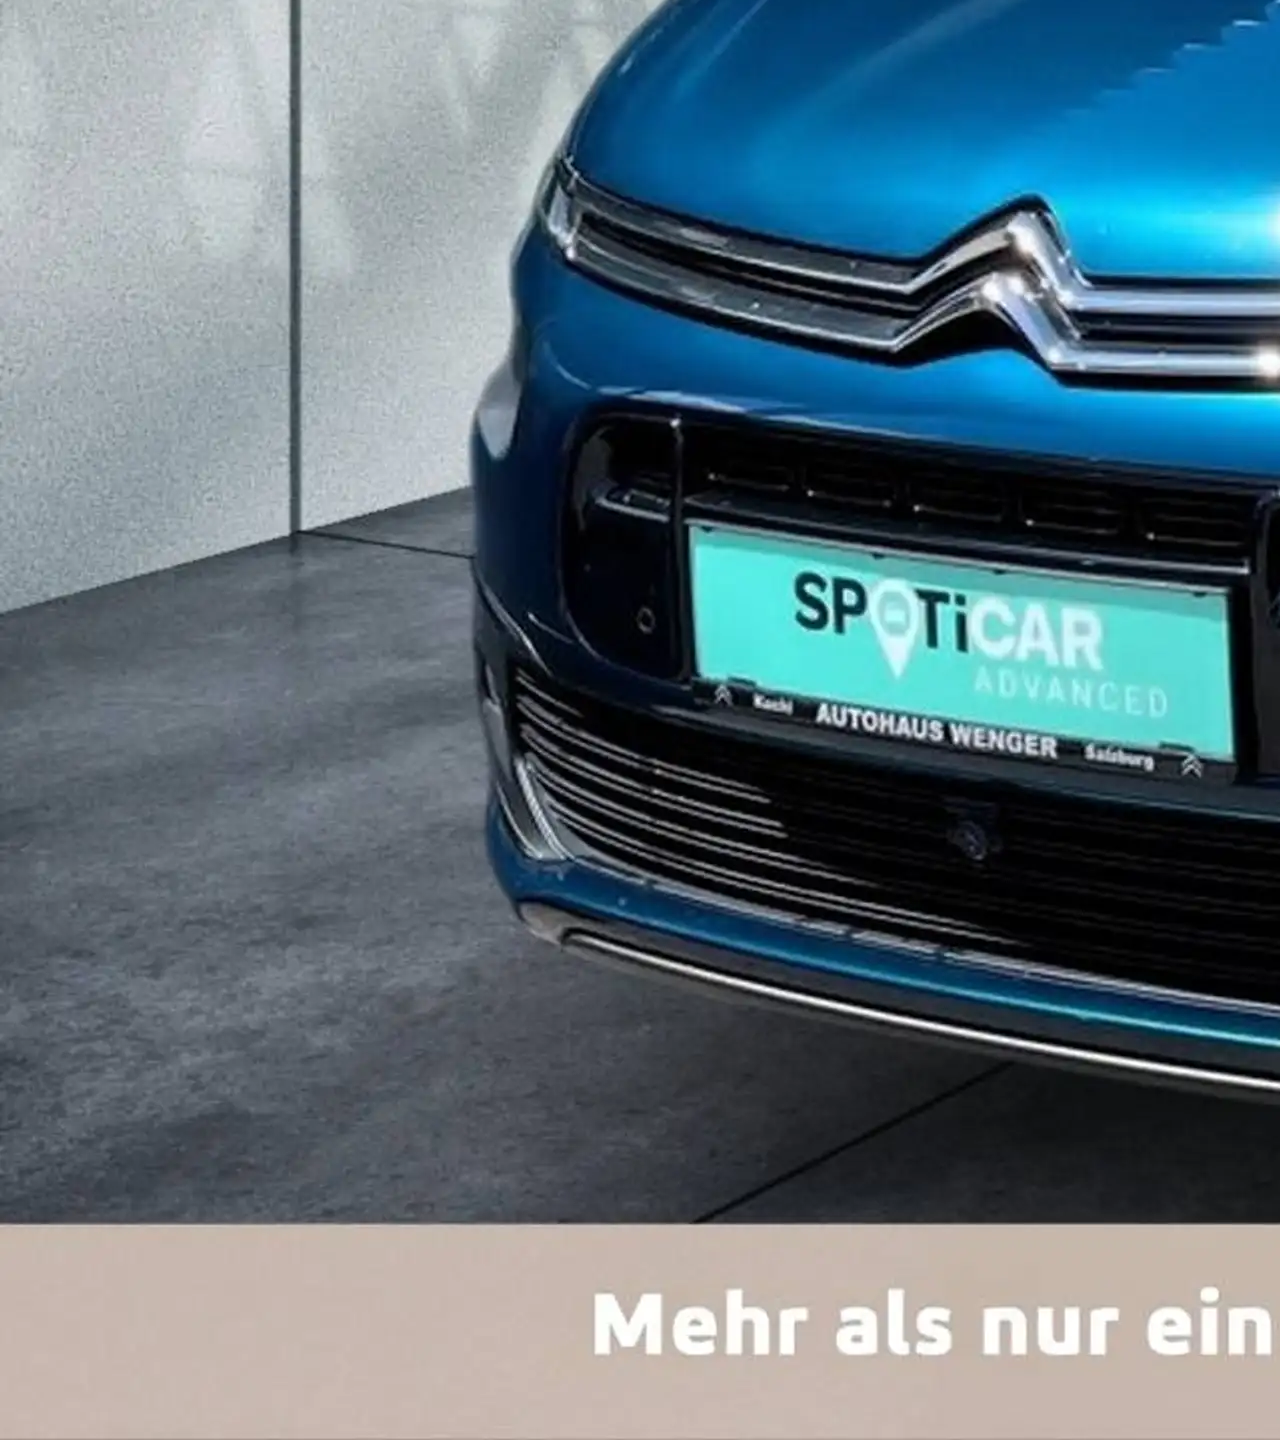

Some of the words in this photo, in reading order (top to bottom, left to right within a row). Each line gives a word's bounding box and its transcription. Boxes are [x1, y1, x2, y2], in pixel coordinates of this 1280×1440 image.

[974, 666, 1168, 719] ADVANCED
[816, 702, 944, 743] AUTOHAUS
[949, 719, 1058, 760] WENGER
